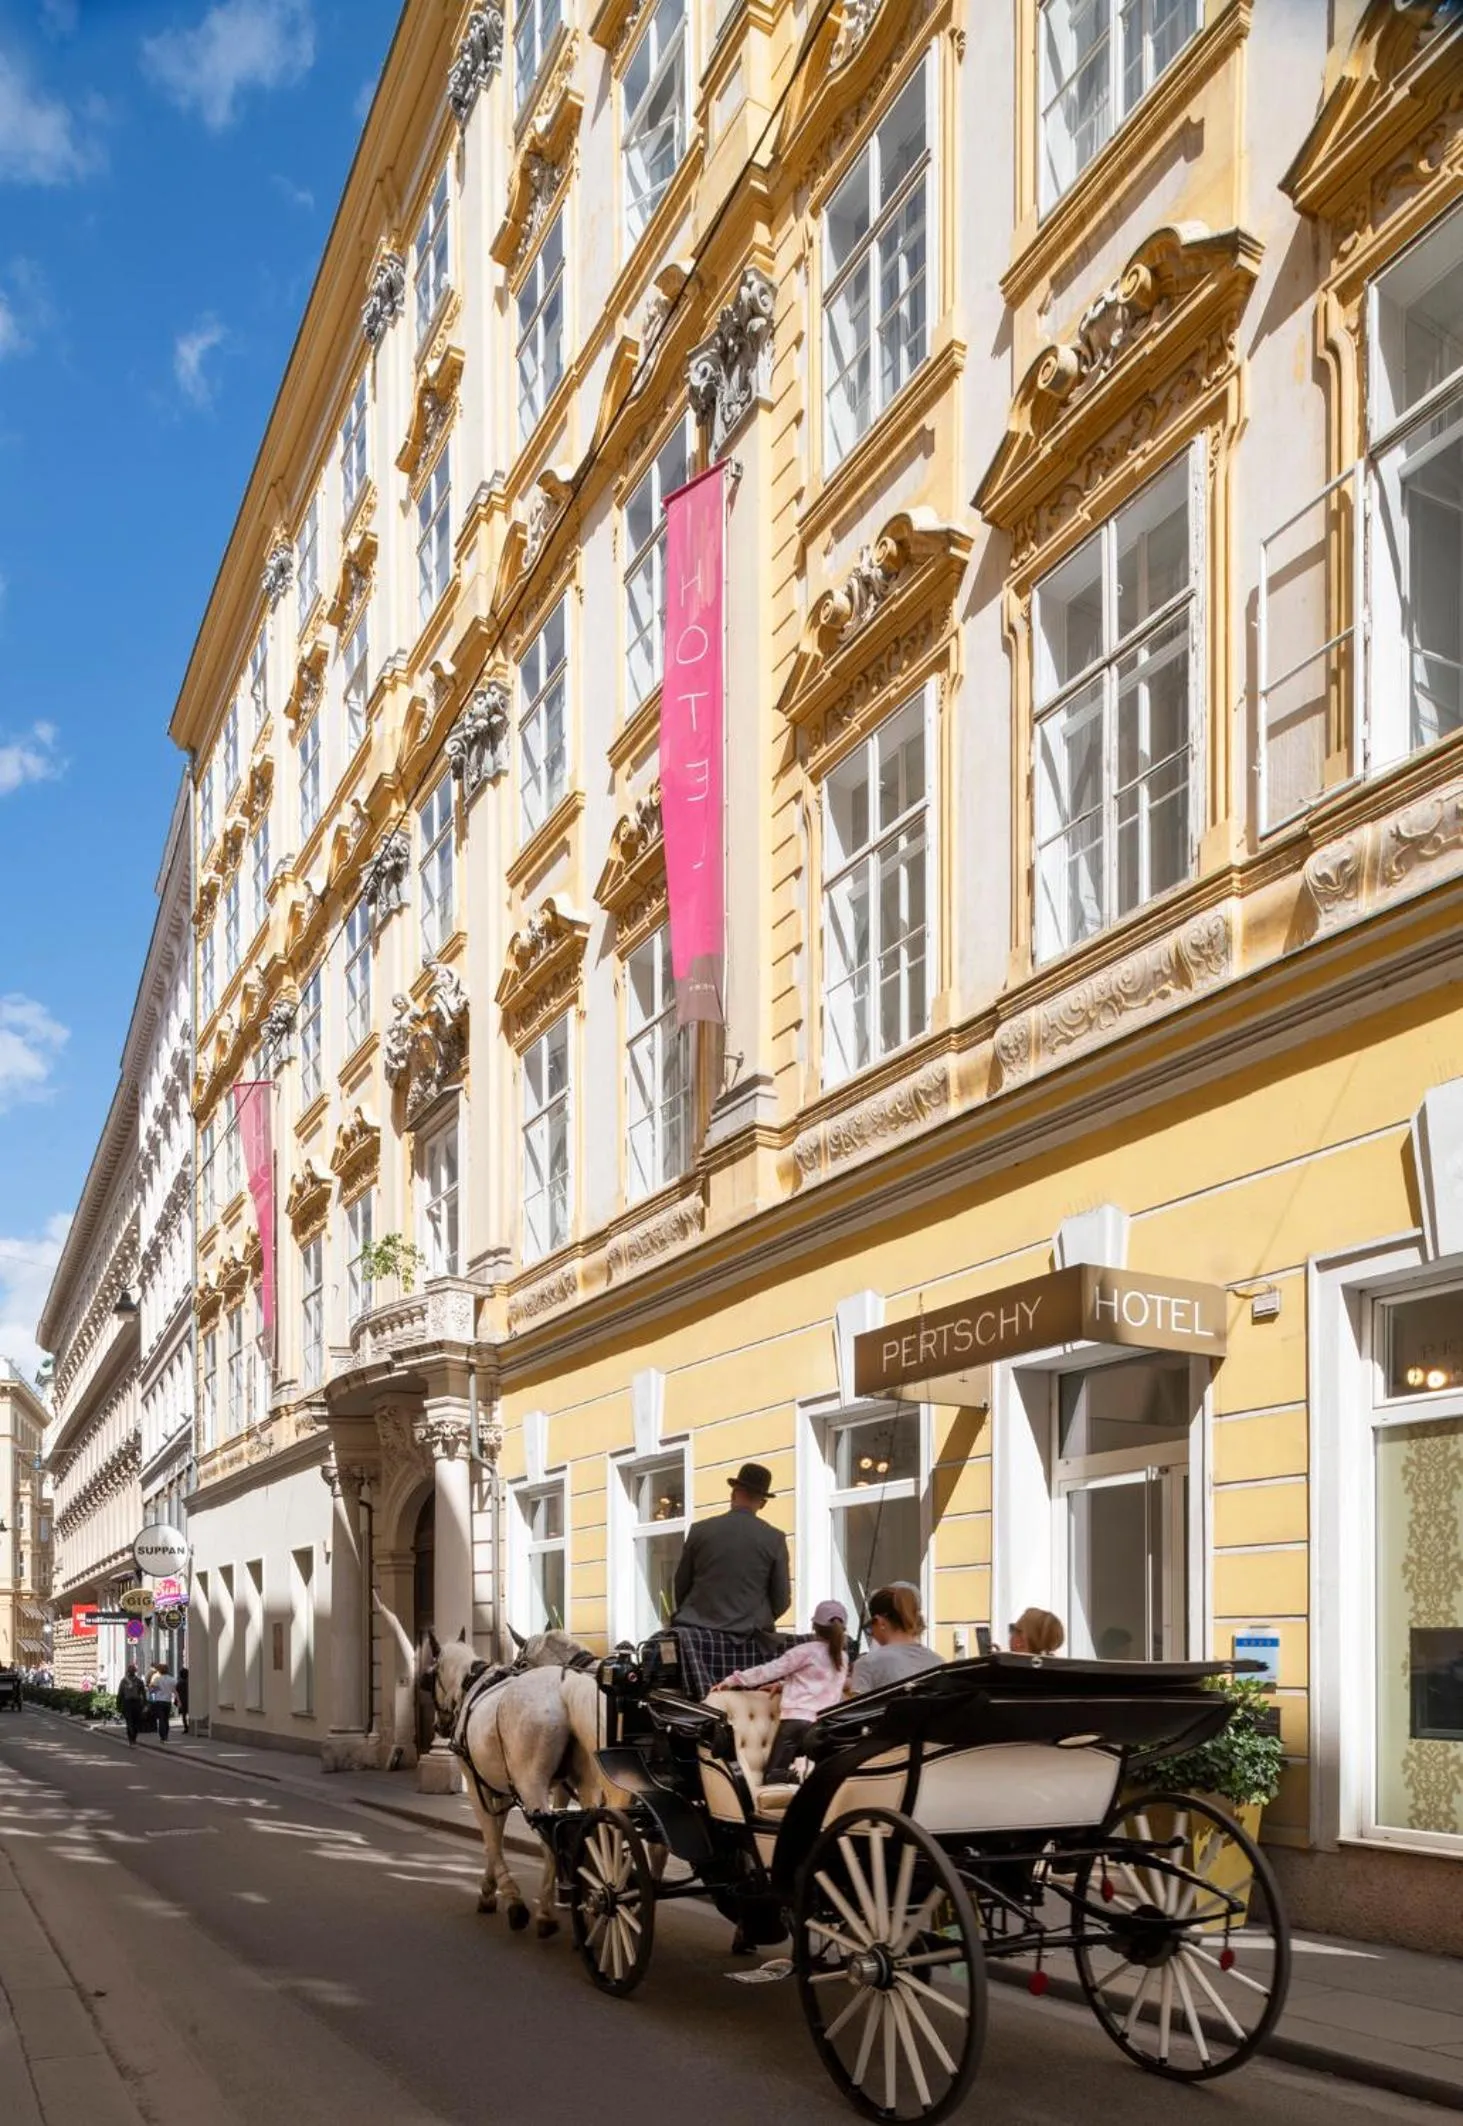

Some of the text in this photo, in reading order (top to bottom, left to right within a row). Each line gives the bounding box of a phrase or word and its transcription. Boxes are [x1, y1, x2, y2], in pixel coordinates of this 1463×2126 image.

[881, 1296, 1043, 1373] PERTSCHY
[1095, 1286, 1215, 1338] HOTEL
[138, 1546, 185, 1555] SUPPAN
